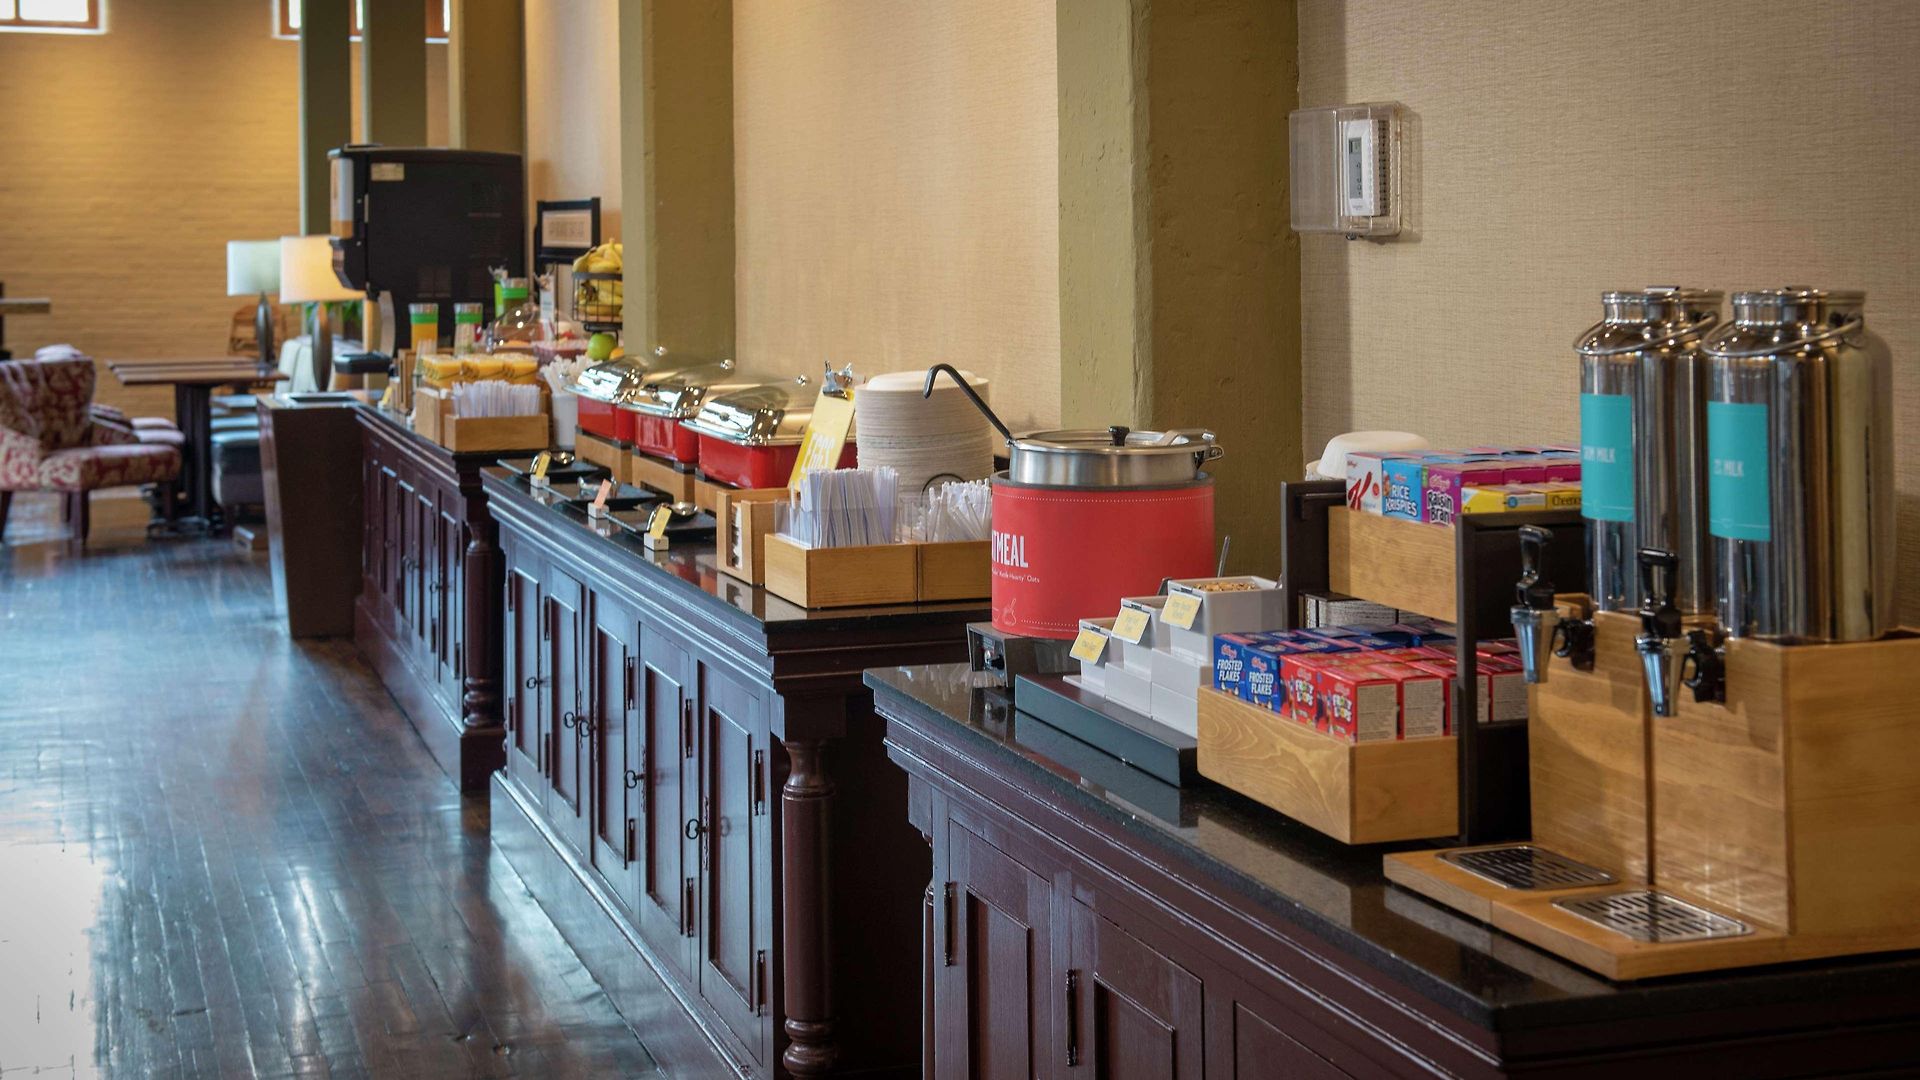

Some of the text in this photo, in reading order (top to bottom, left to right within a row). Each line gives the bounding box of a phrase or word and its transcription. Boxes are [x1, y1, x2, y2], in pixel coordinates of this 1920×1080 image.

[1391, 484, 1410, 500] RICE
[1385, 498, 1417, 517] KRISPIES
[1427, 489, 1454, 514] Raisin
[1430, 507, 1451, 525] Bran
[992, 529, 1029, 568] TMEAL
[1027, 574, 1040, 583] Oats
[1217, 659, 1243, 671] FROSTED
[1219, 670, 1240, 682] FLAKES
[1249, 671, 1274, 684] FROSTED
[1251, 683, 1272, 696] FLAKES
